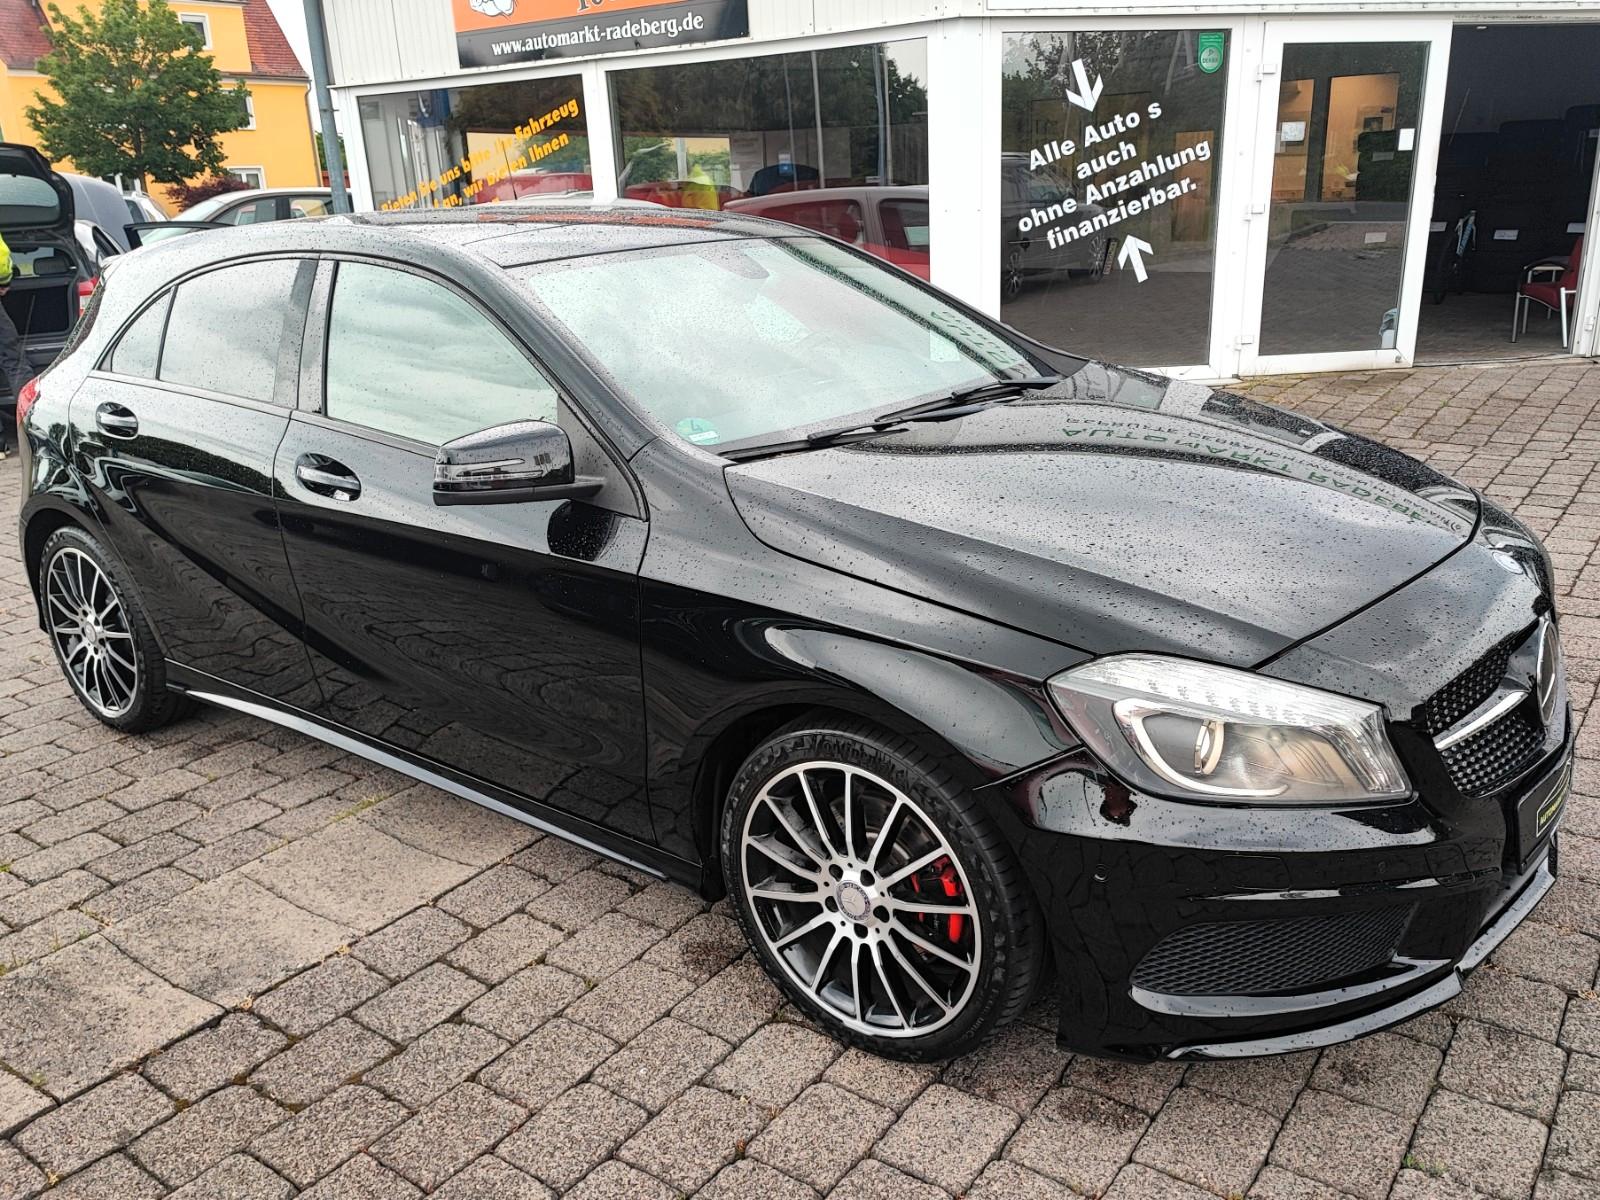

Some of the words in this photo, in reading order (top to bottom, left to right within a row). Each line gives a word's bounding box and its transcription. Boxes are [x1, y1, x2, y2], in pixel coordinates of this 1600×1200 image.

[491, 12, 704, 56] www.automarkt-radeberg.de
[439, 165, 461, 186] uns
[514, 98, 579, 141] Fahrzeug
[463, 179, 484, 198] wir
[527, 132, 569, 163] Ihnen
[1029, 138, 1076, 171] Alle
[1084, 111, 1141, 148] Auto
[1076, 140, 1138, 181] auch
[1018, 196, 1077, 233] ohne
[1086, 139, 1212, 206] Anzahlung
[1046, 176, 1197, 250] finanzierbar.
